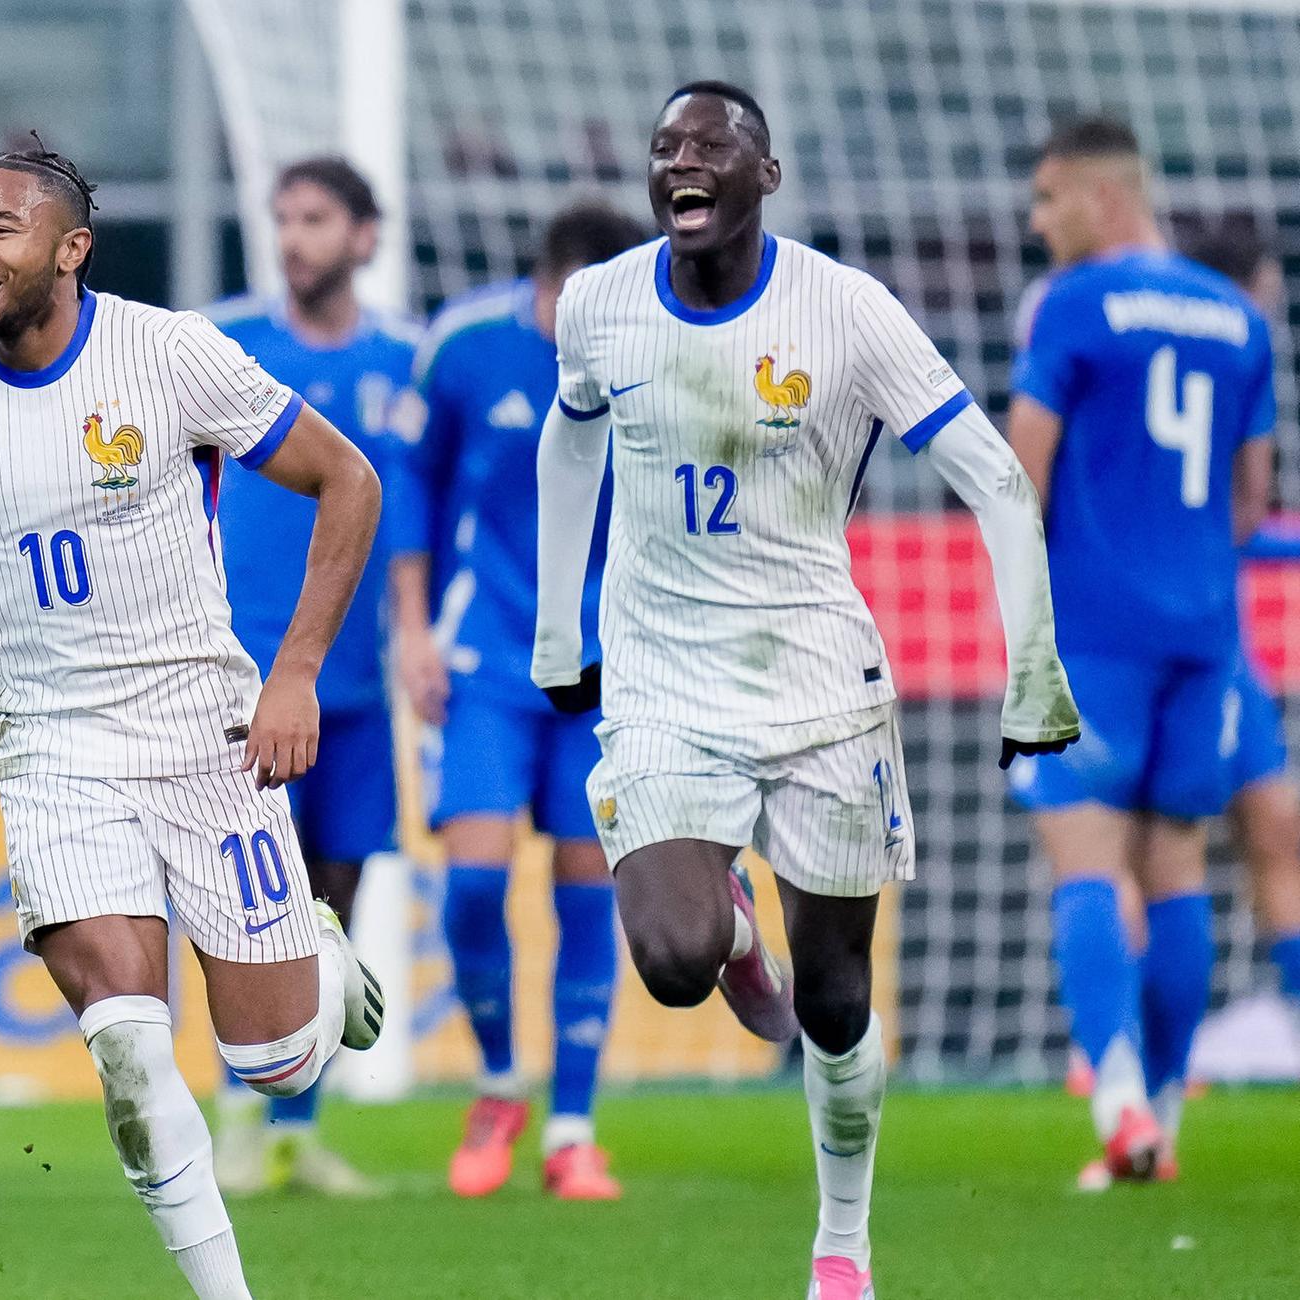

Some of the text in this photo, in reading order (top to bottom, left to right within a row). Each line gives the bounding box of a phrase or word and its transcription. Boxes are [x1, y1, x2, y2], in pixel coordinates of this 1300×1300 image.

[1145, 344, 1214, 508] 4
[675, 463, 741, 536] 12
[18, 529, 94, 611] 10
[220, 829, 292, 911] 10
